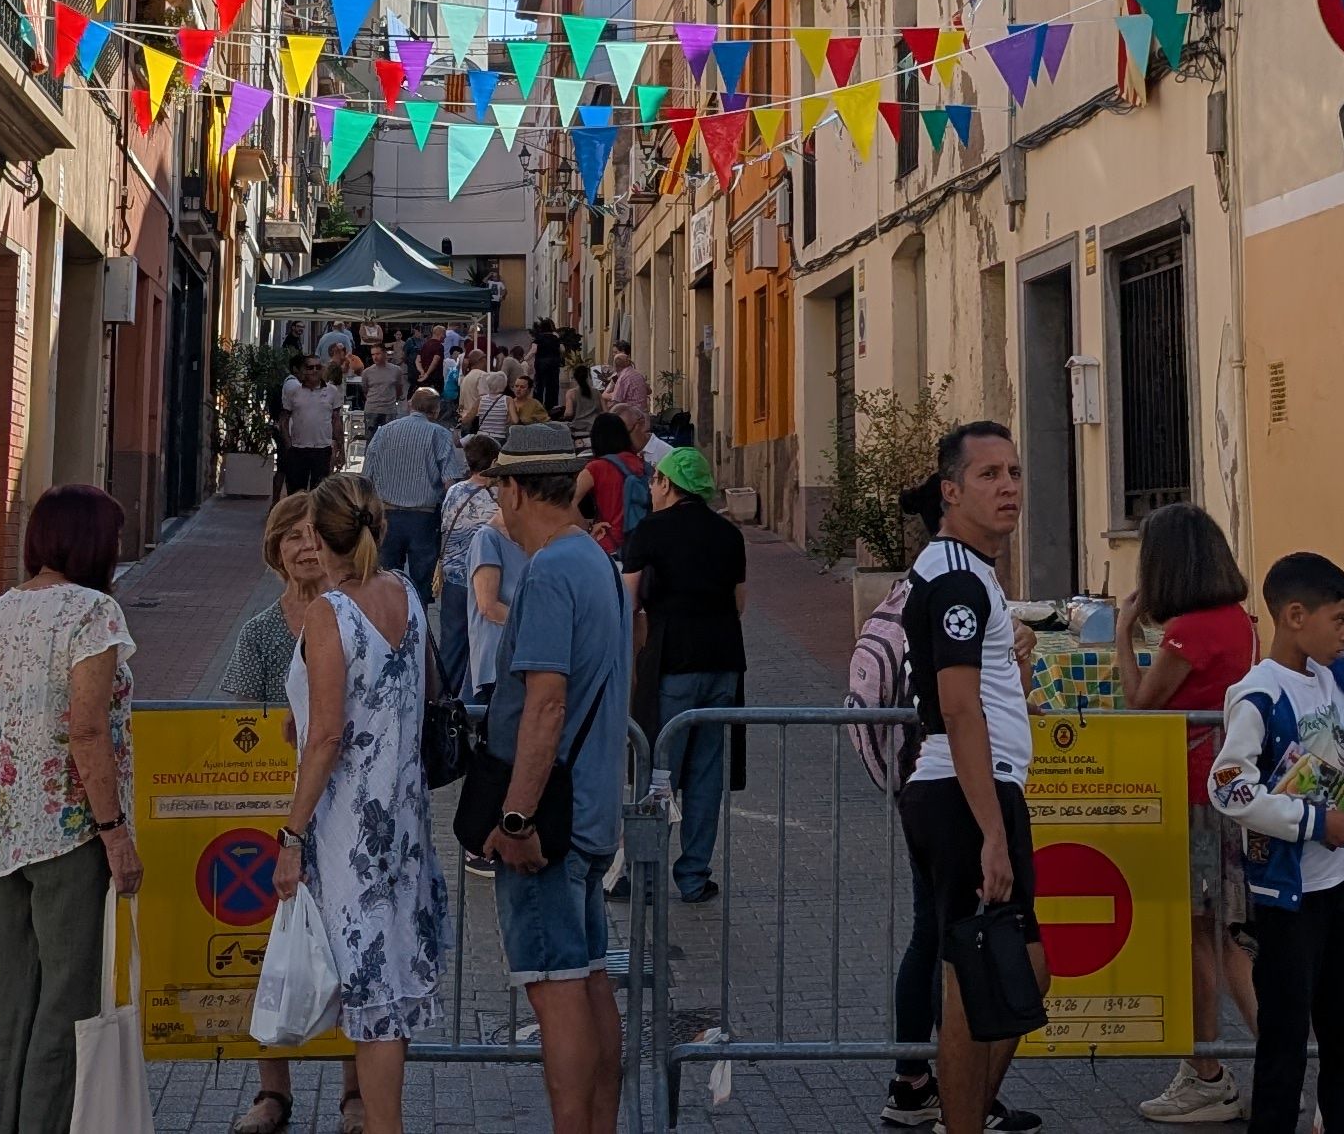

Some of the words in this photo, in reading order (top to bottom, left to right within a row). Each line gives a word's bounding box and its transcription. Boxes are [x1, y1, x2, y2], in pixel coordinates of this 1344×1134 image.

[256, 759, 267, 767] de
[1068, 755, 1097, 764] LOCAL
[152, 770, 249, 785] SENYALITZACIÓ
[1072, 783, 1161, 794] EXCEPCIONAL
[1059, 805, 1083, 816] DELS
